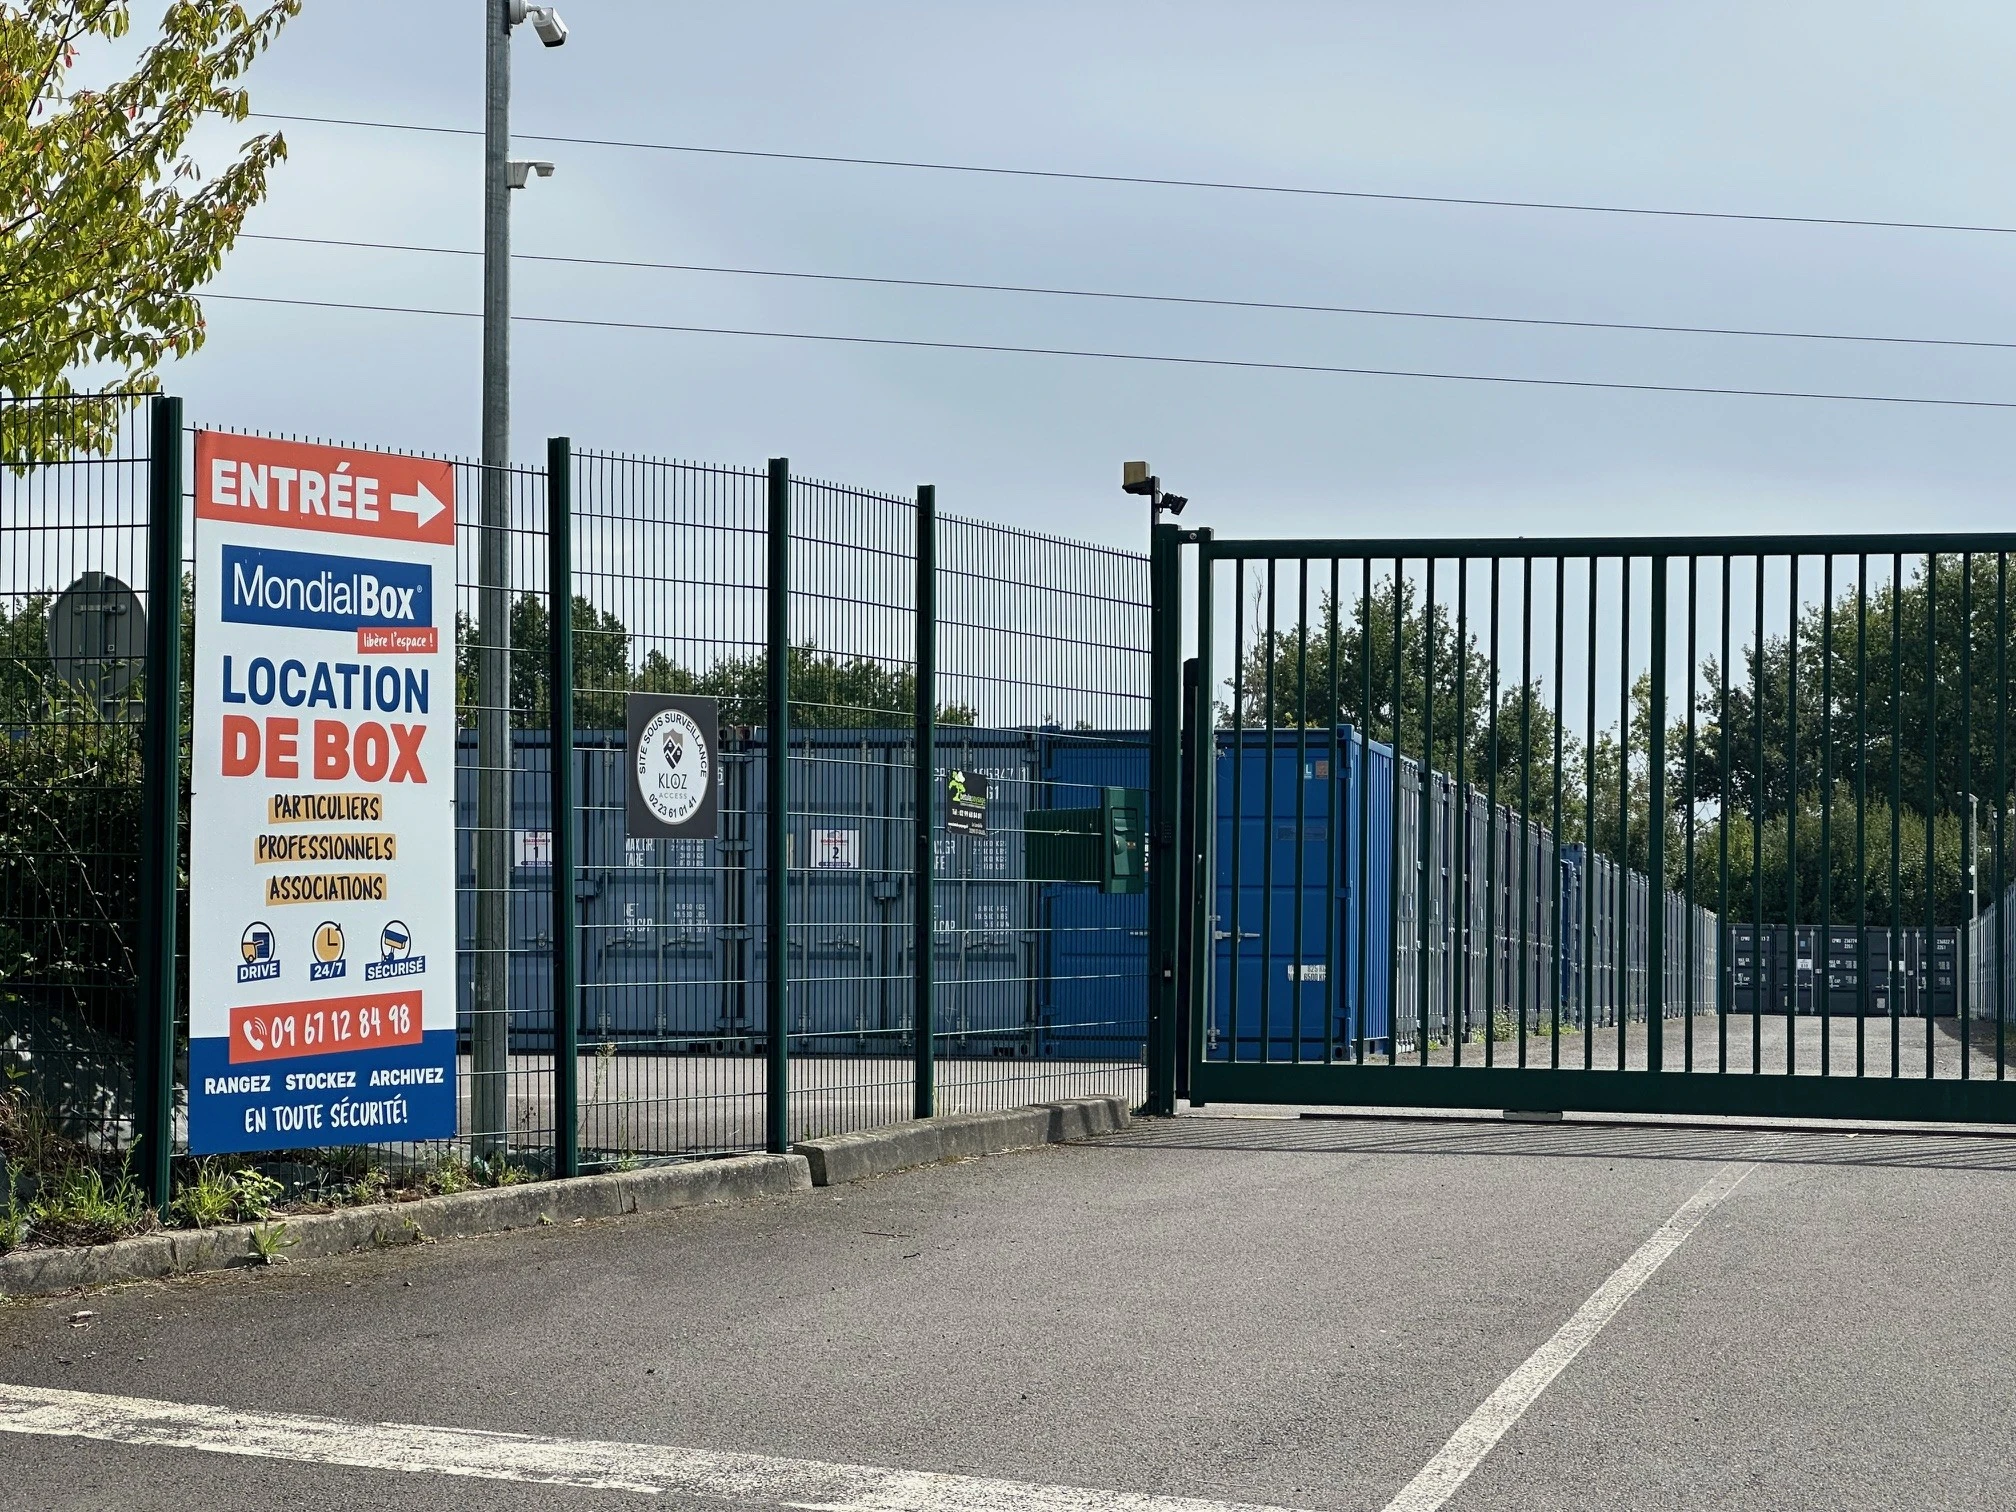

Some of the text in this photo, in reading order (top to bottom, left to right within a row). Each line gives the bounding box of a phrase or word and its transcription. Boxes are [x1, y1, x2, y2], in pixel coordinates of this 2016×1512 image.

[211, 458, 380, 522] ENTRÉE
[363, 632, 388, 647] libère
[391, 631, 427, 651] l'espace
[222, 655, 429, 714] LOCATION
[643, 716, 664, 744] SOUS
[222, 715, 428, 784] DE BOX
[664, 713, 708, 778] SURVEILLANCE
[639, 745, 648, 775] SITE
[658, 772, 688, 790] KLOZ
[274, 794, 379, 821] PARTICULIERS
[648, 793, 697, 818] 02 23 61 01 41
[659, 792, 688, 800] ACCESS
[258, 834, 394, 861] PROFESSIONNELS
[832, 846, 839, 859] 2
[270, 875, 383, 901] ASSOCIATIONS
[240, 963, 278, 981] DRIVE
[314, 961, 343, 979] 24/7
[367, 958, 424, 980] SÉCURISÉ
[271, 1003, 410, 1049] 09 67 12 84 98
[205, 1067, 444, 1094] RANGEZ STOCKEZ ARCHIVEZ
[245, 1093, 408, 1133] EN TOUTE SÉCURITÉ!
